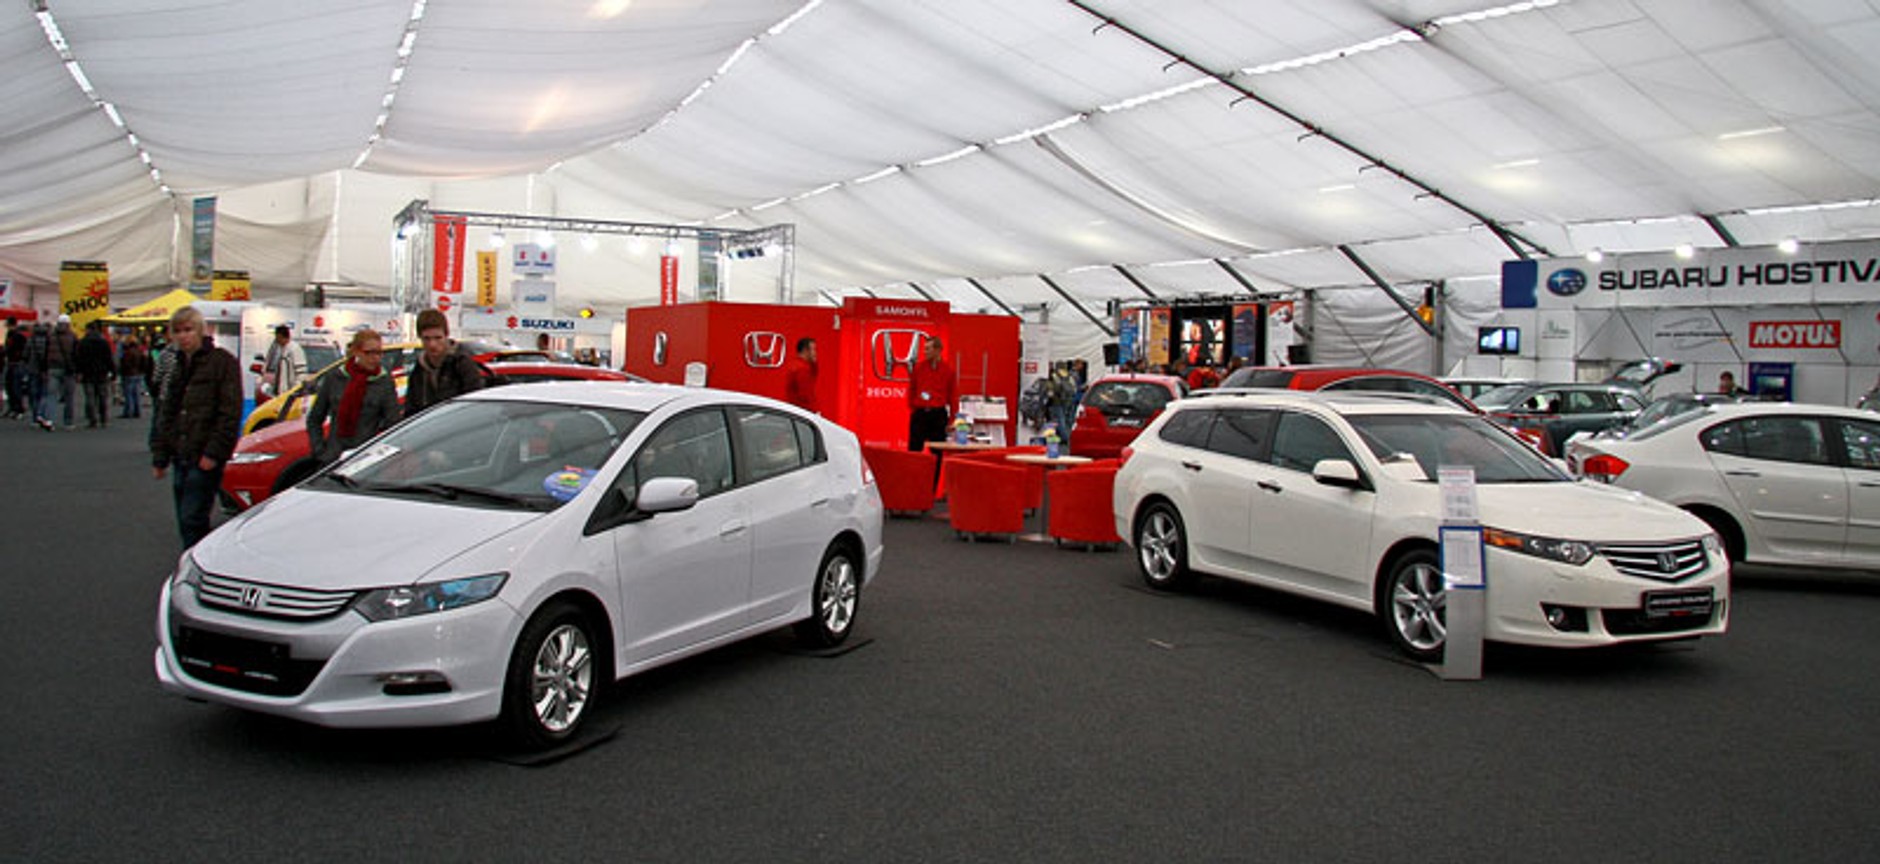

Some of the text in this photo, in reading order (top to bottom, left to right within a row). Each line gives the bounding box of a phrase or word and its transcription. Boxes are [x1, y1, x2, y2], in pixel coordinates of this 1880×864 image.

[1598, 266, 1728, 291] SUBARU
[875, 305, 928, 318] SAMOHYL
[522, 319, 574, 329] SUZUKI
[1753, 324, 1836, 347] MOTUL
[866, 387, 906, 398] HON
